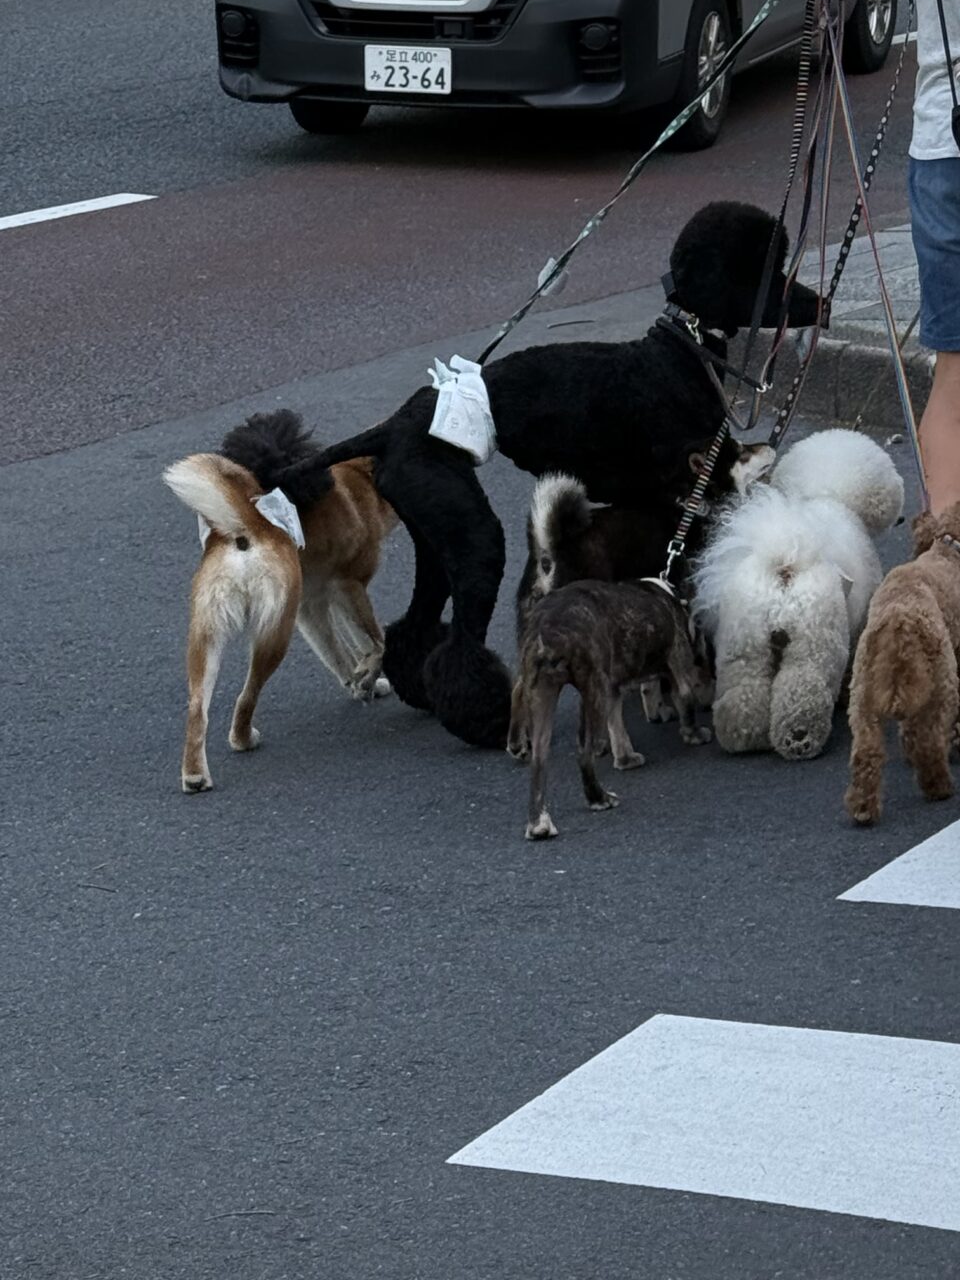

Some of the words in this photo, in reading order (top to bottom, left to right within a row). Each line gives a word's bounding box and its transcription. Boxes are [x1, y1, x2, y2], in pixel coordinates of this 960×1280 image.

[385, 49, 410, 63] 足立
[411, 51, 433, 63] 400
[384, 65, 446, 90] 23-64
